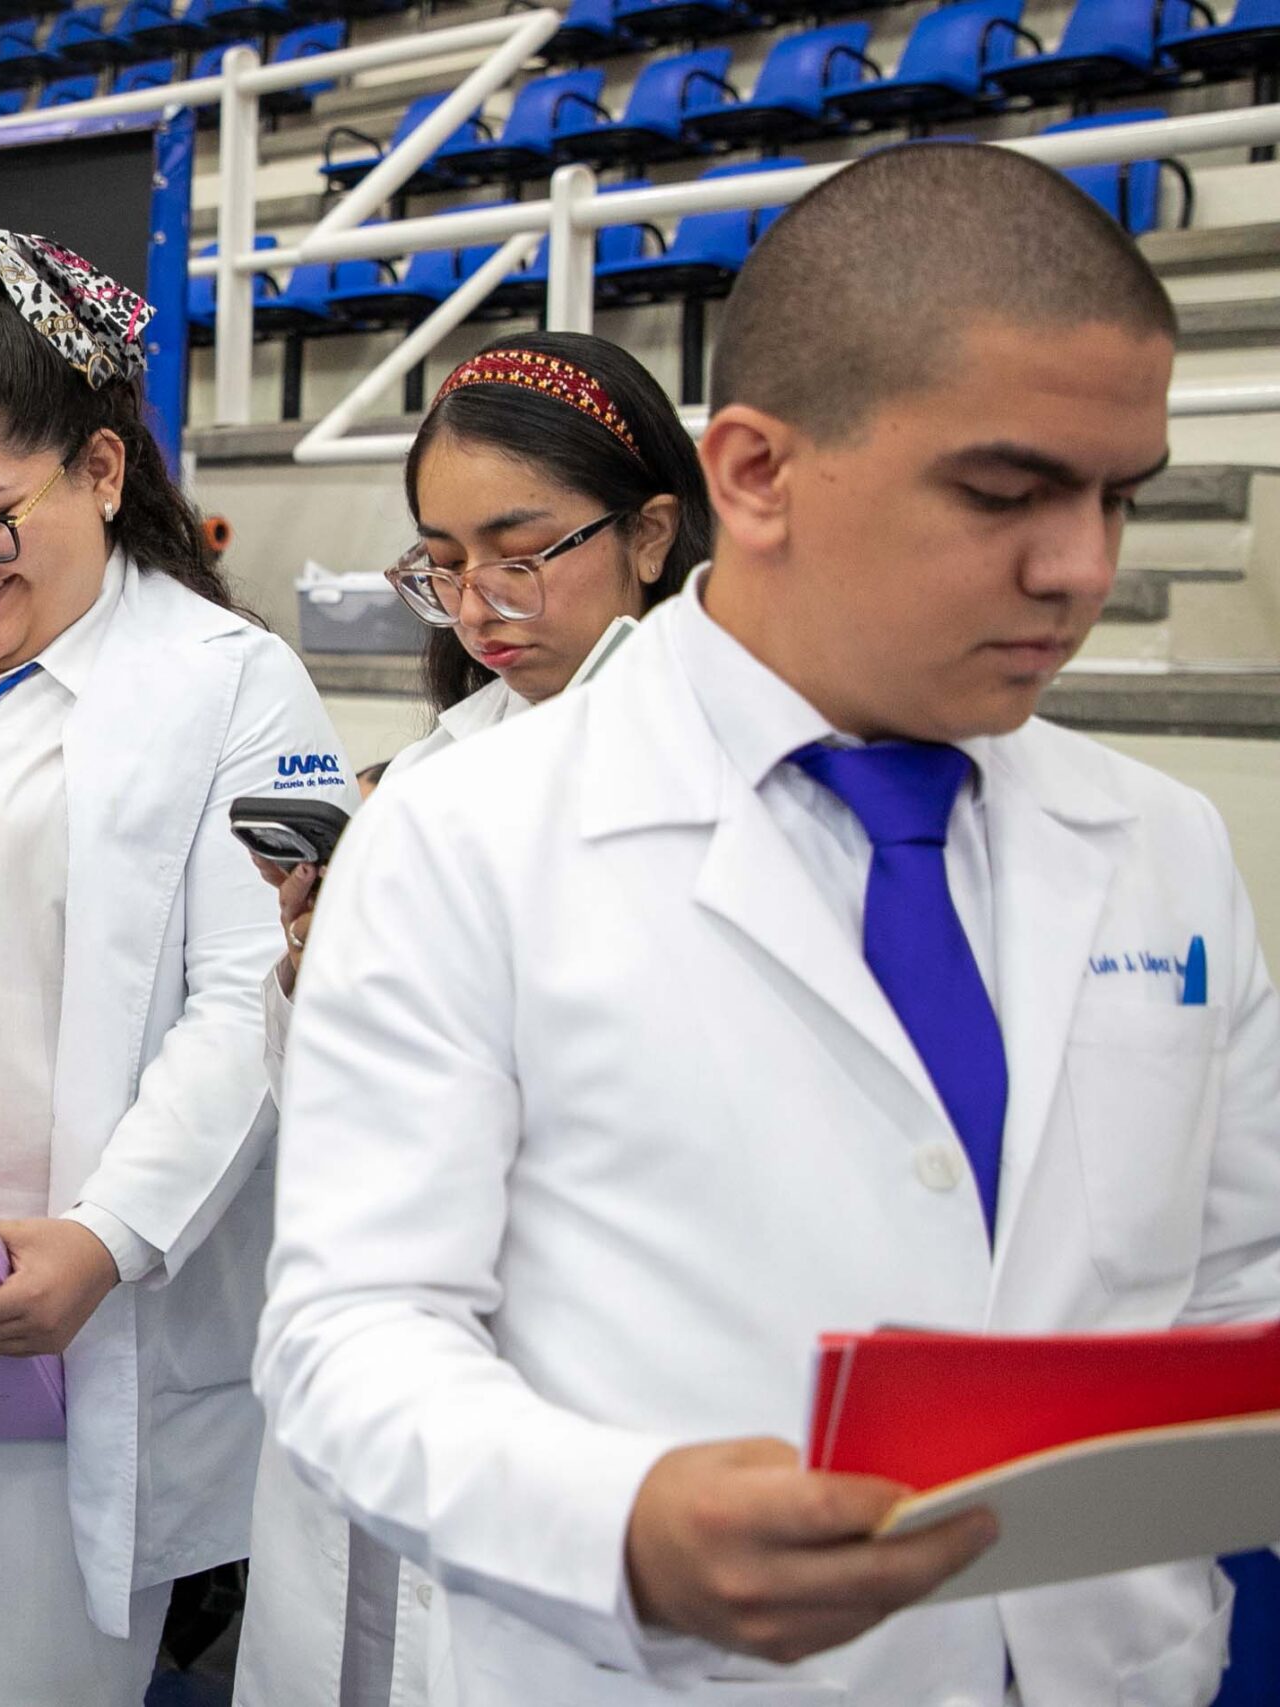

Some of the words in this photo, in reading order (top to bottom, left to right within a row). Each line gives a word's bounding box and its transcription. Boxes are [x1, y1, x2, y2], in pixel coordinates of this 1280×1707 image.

[278, 754, 339, 776] UVAQ
[274, 780, 304, 790] Escuela
[307, 778, 316, 787] de
[318, 776, 345, 786] Medicina
[1089, 954, 1119, 974] Luis
